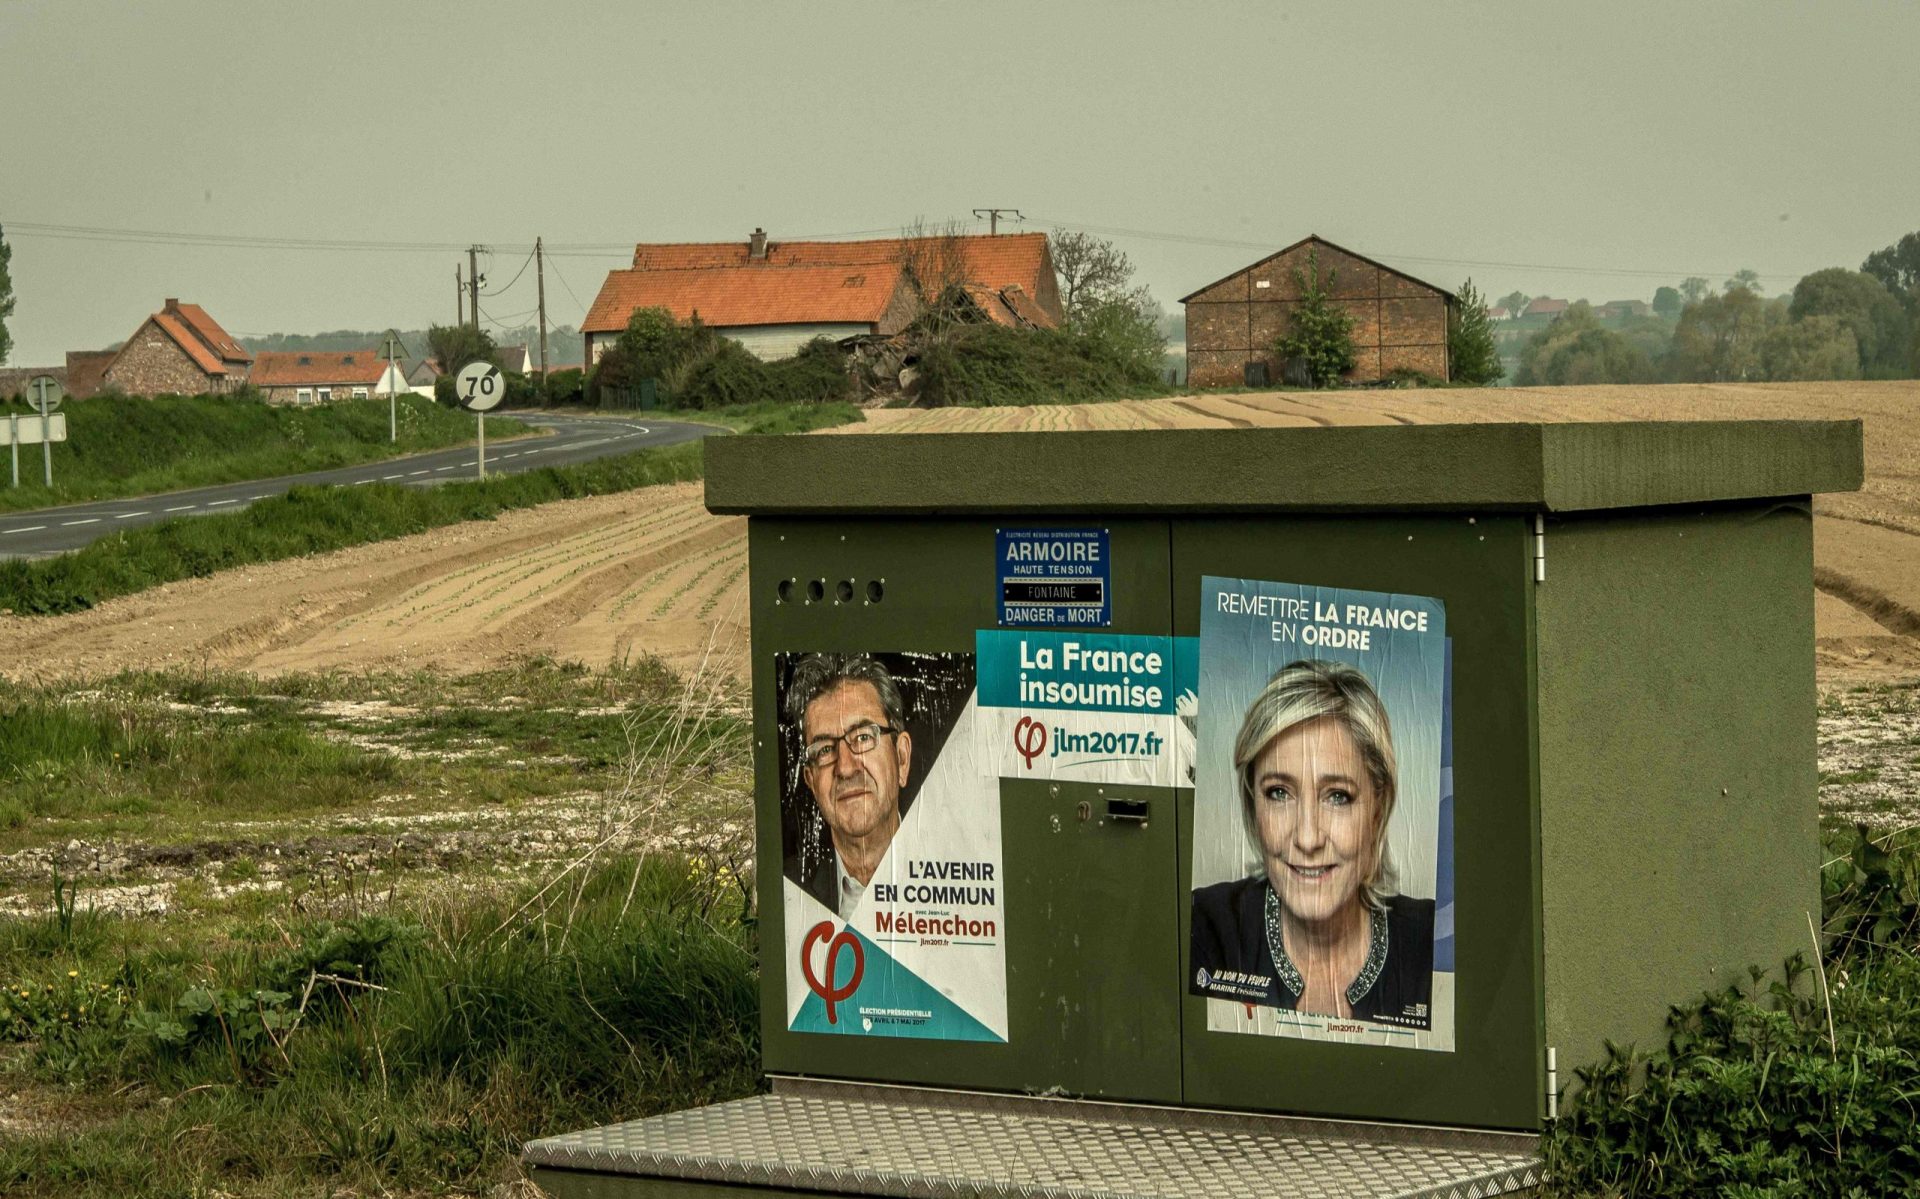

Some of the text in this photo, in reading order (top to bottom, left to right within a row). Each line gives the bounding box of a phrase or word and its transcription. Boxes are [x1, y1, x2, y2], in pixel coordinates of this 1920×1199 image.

[466, 376, 494, 395] 70
[1006, 541, 1100, 562] ARMOIRE
[1013, 565, 1093, 575] HAUTE TENSION
[1028, 586, 1077, 599] FONTAINE
[1005, 607, 1055, 622] DANGER
[1067, 608, 1102, 623] MORT
[1217, 592, 1428, 632] REMETTRE LA FRANCE
[1271, 621, 1371, 651] EN ORDRE
[1020, 640, 1163, 675] La France
[1020, 672, 1163, 708] insoumise
[1050, 726, 1163, 758] jlm2017.fr
[908, 860, 995, 881] L'AVENIR
[874, 884, 995, 906] EN COMMUN
[875, 911, 996, 937] Mélenchon
[920, 937, 949, 946] jlm2017.fr
[1209, 983, 1237, 994] MARINE
[1212, 969, 1272, 988] AU NOM DU PEUPLE
[859, 1006, 932, 1017] ÉLECTION PRÉSIDENTIELLE
[1327, 1022, 1364, 1033] jlm2017.fr
